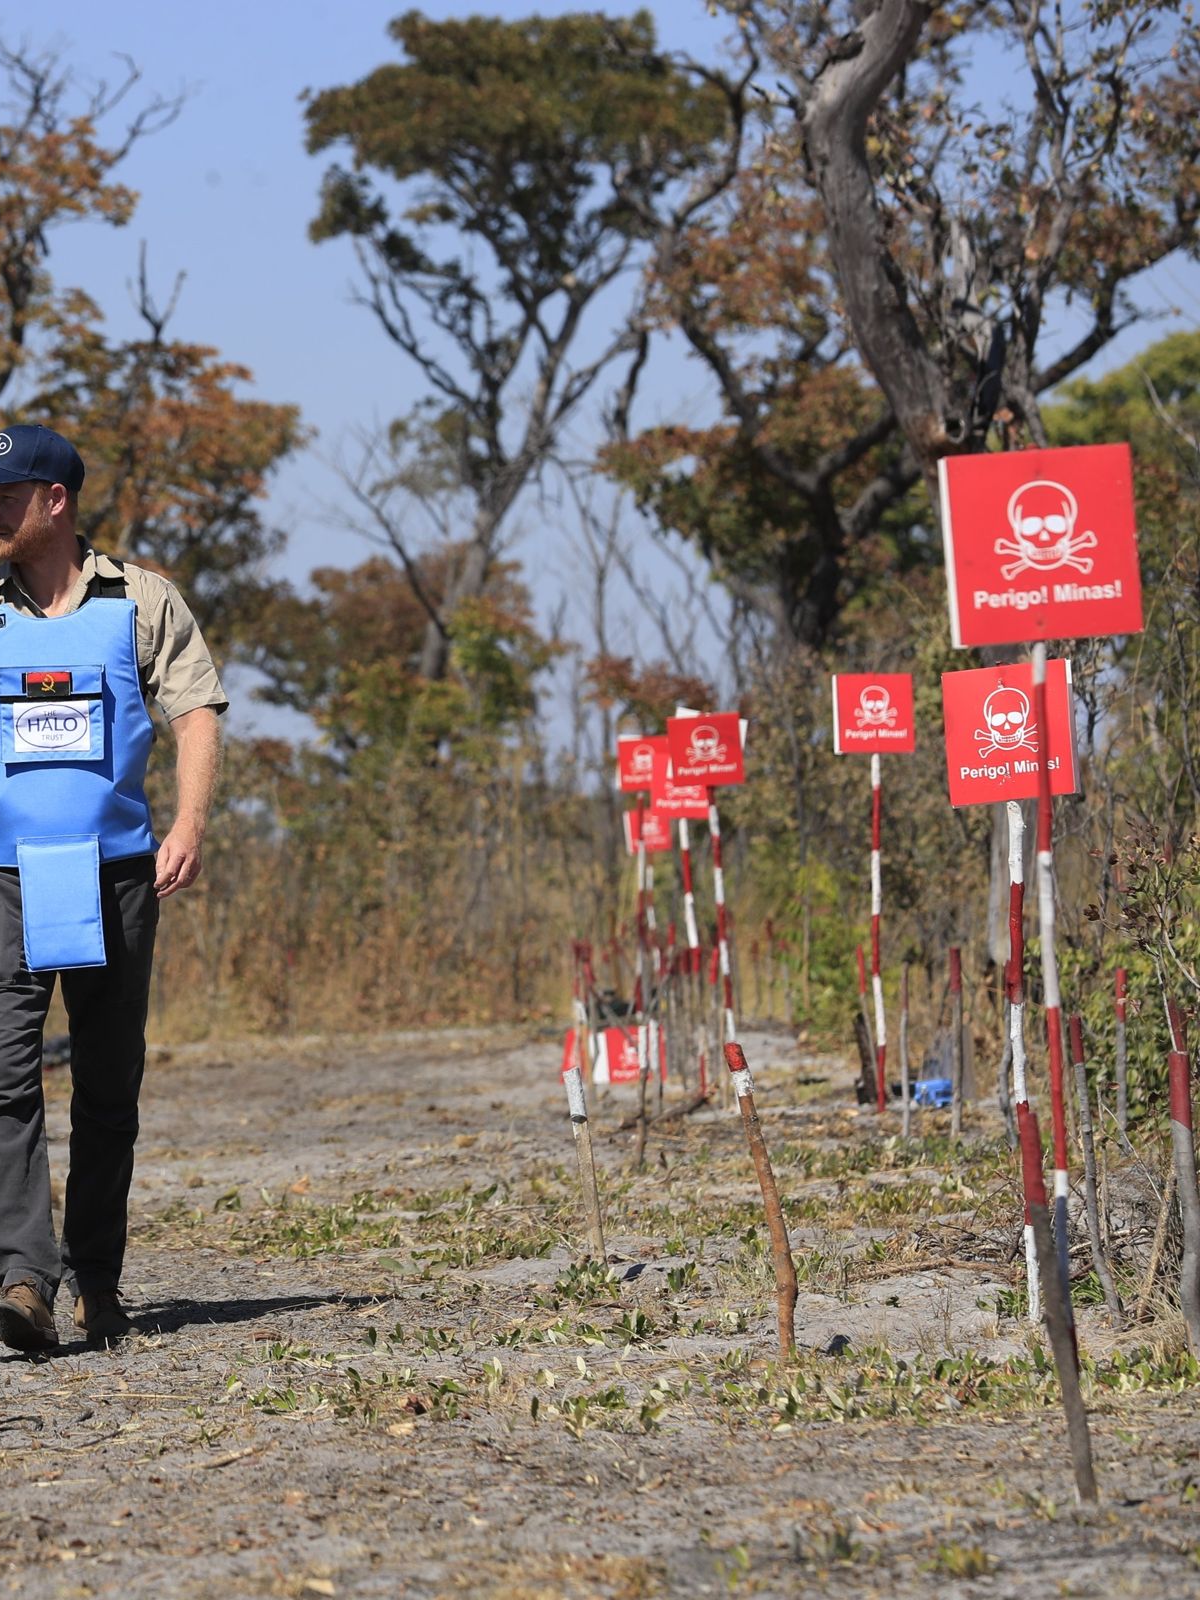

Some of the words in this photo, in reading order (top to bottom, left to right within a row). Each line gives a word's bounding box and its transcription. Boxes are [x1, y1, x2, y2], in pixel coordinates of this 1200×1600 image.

[973, 586, 1048, 610] Perigo!
[1053, 580, 1122, 603] Minas!
[27, 717, 78, 732] HALO
[845, 728, 877, 740] Perigo!
[878, 728, 908, 738] Minas!
[960, 763, 1010, 779] Perigo!
[1014, 757, 1060, 773] Mins!
